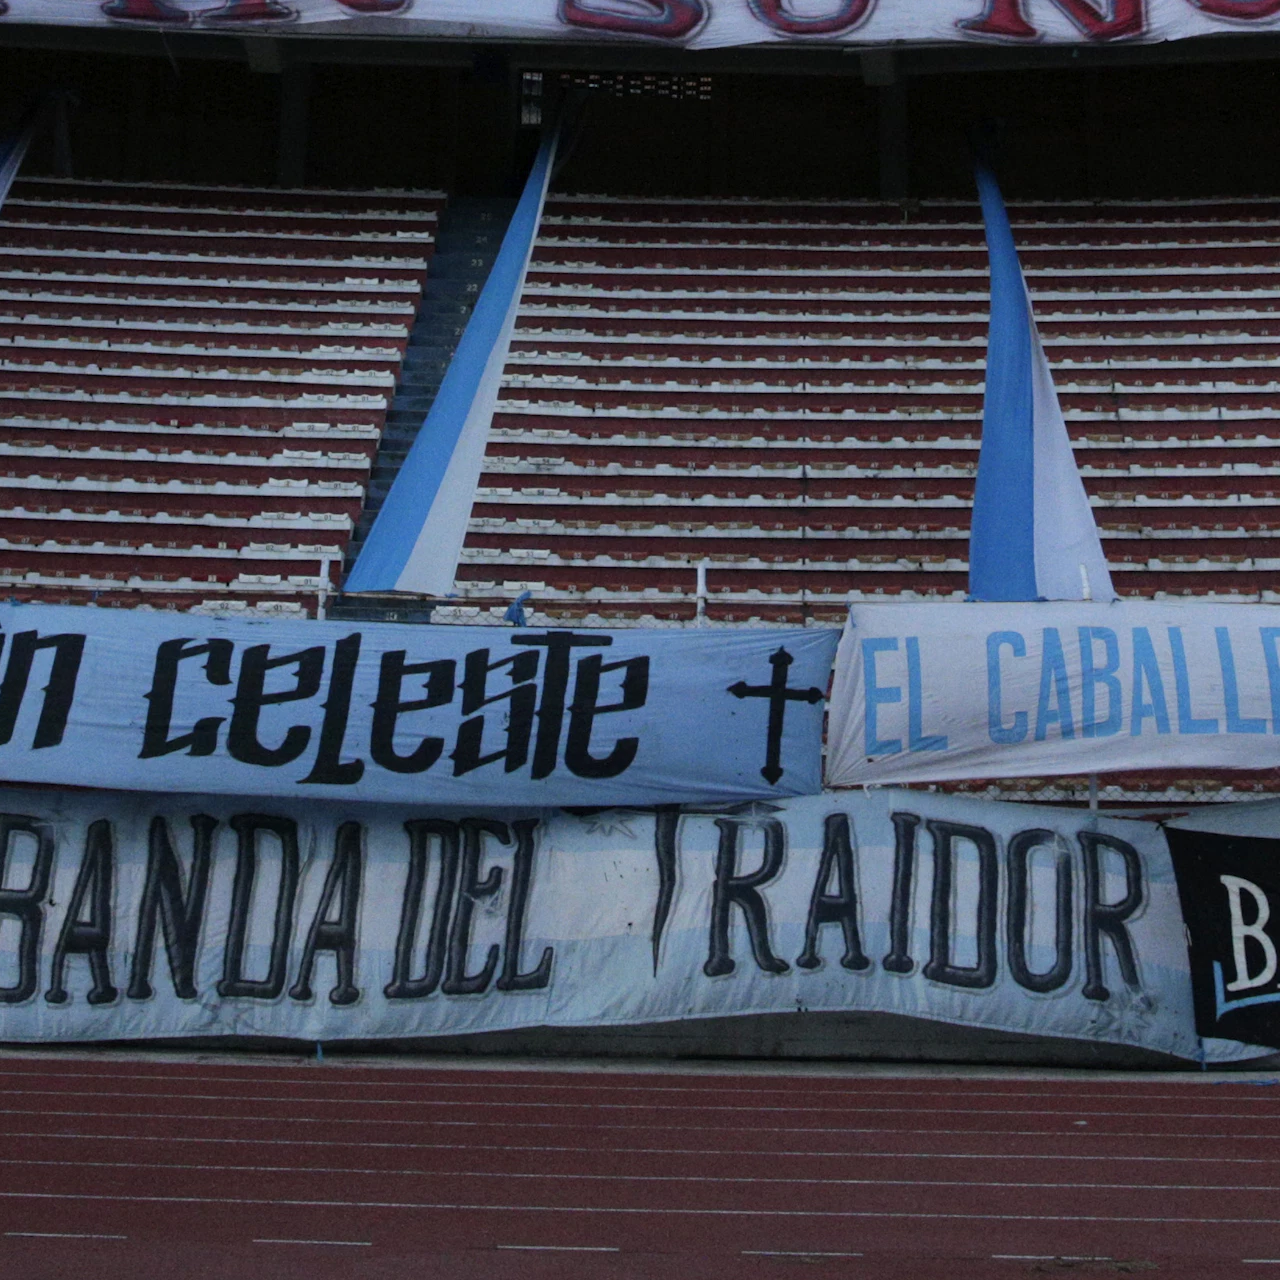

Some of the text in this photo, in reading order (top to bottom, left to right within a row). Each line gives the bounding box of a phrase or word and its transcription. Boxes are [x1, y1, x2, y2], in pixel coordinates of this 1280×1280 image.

[860, 635, 949, 756] EL
[383, 814, 554, 999] DEL
[561, 802, 1144, 1002] TRAIDOR
